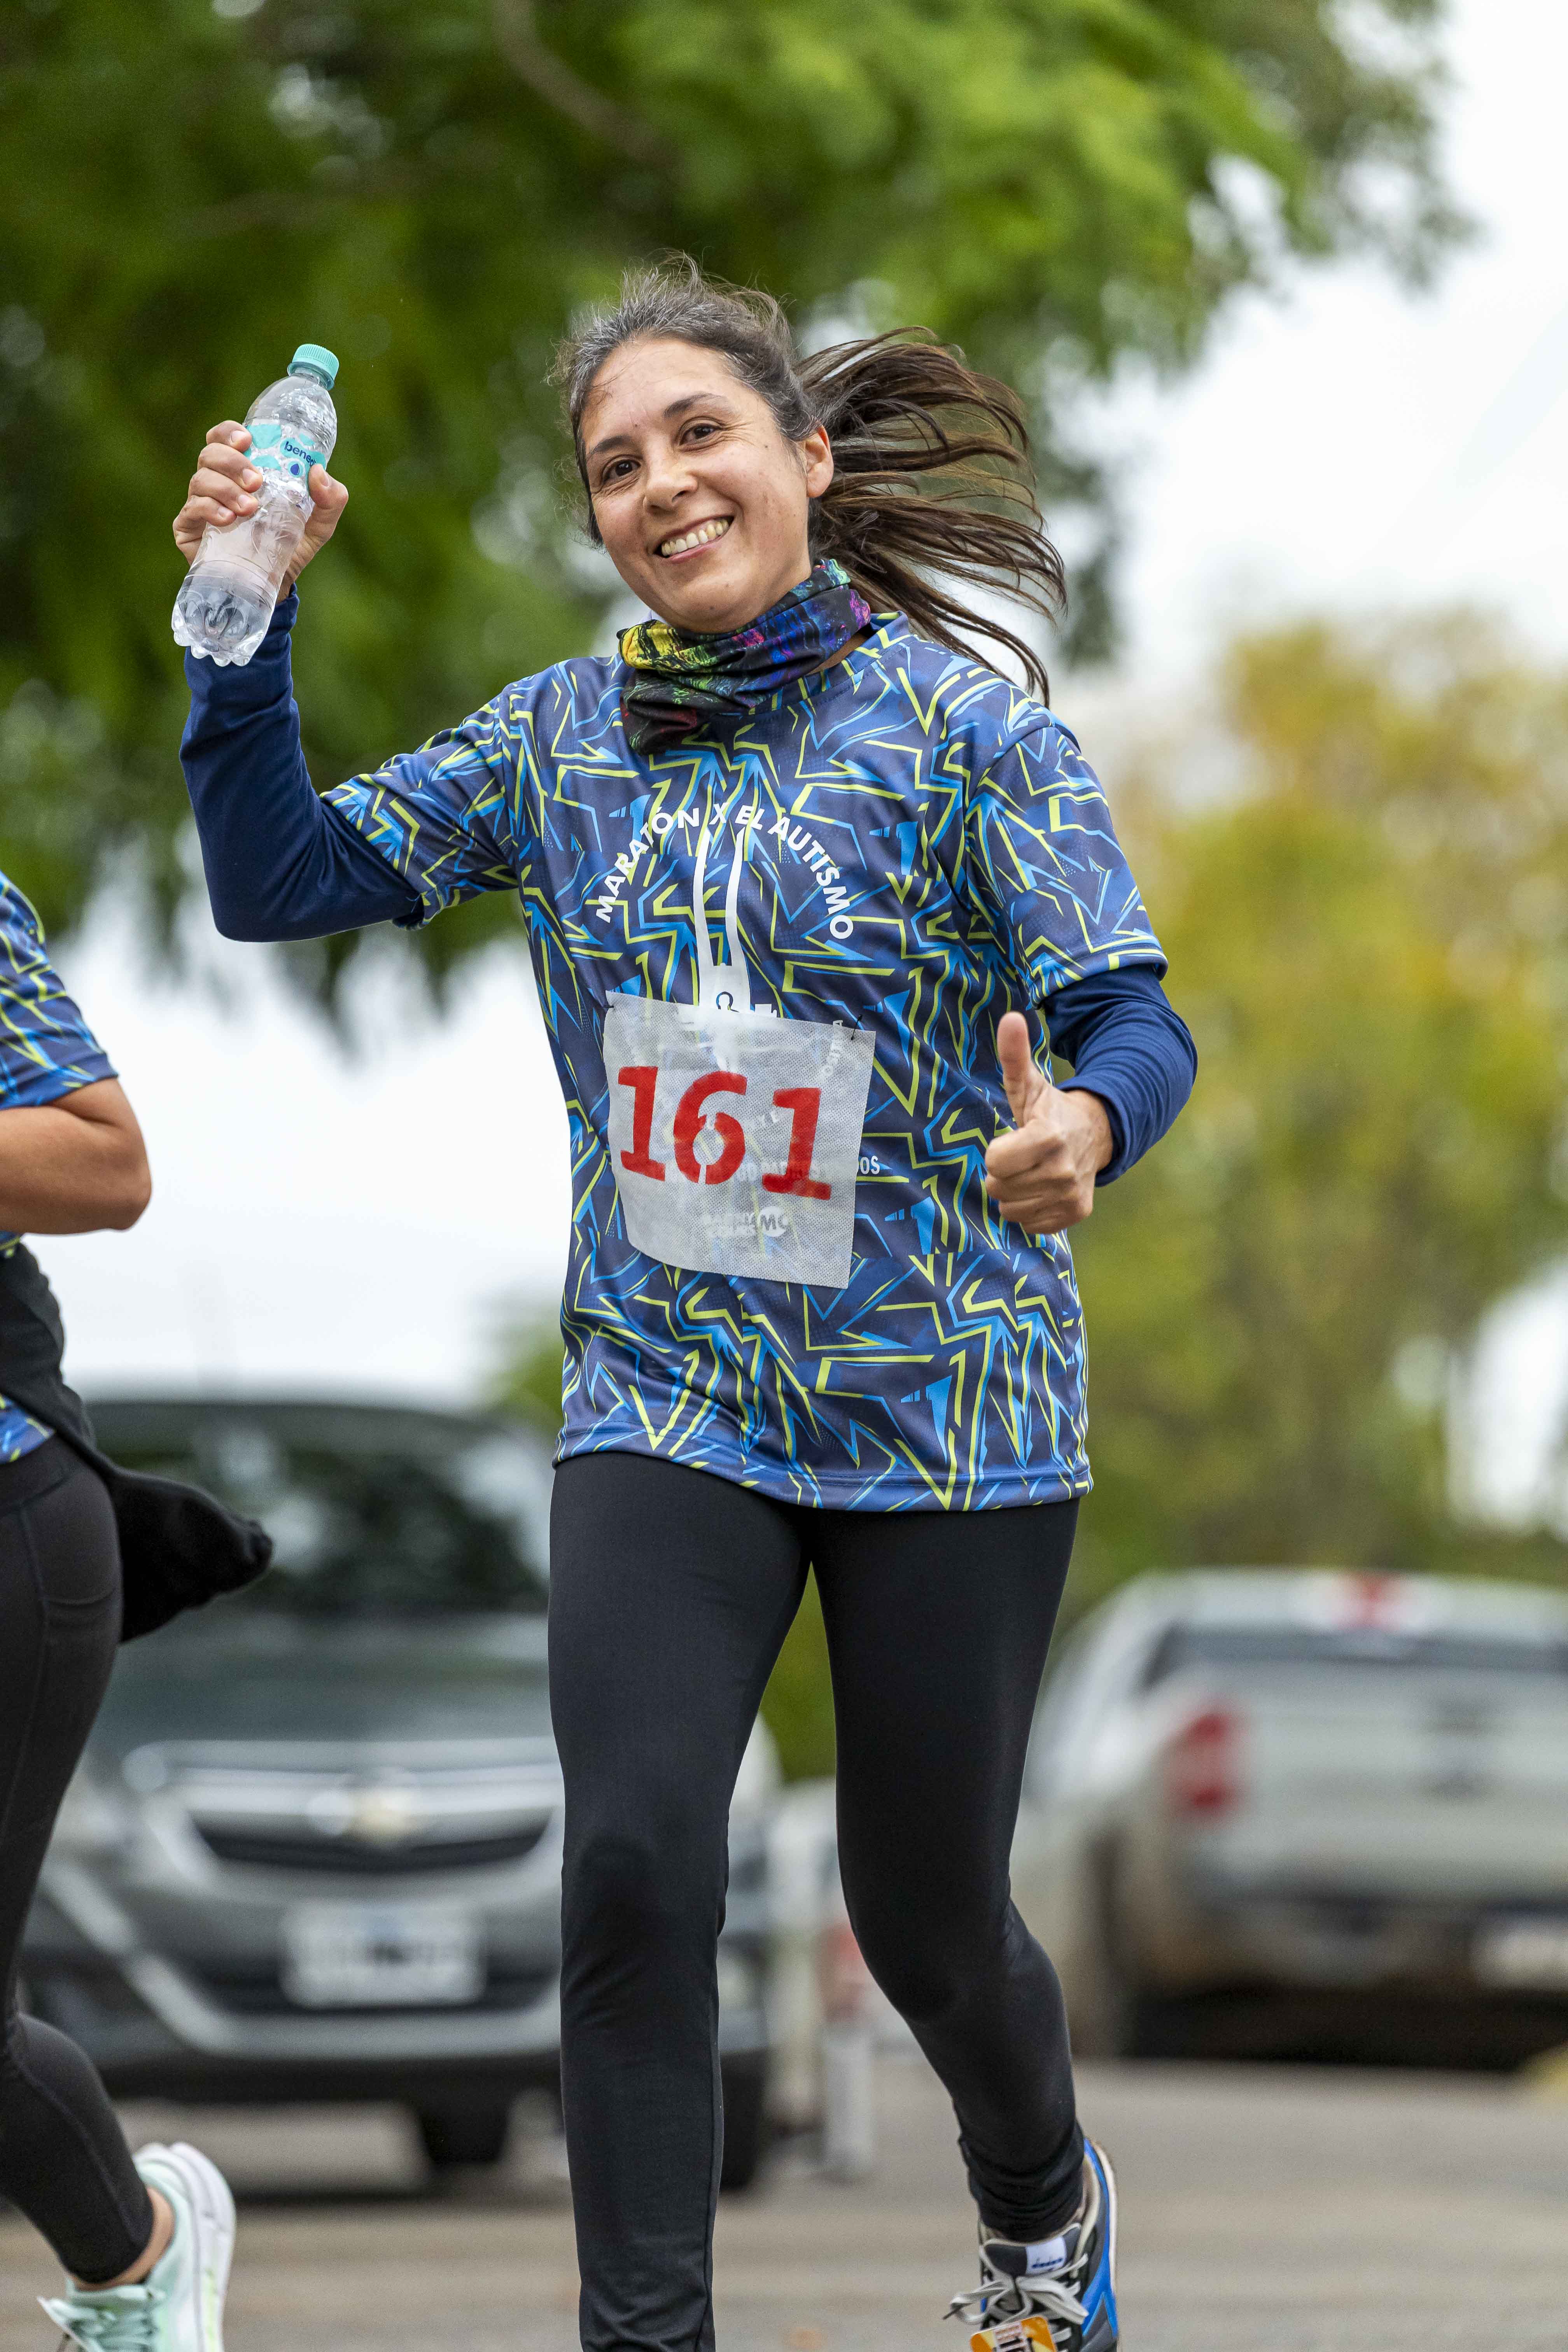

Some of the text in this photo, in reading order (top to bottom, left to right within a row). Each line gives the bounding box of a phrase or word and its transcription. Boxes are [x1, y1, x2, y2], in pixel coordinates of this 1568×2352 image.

[595, 802, 854, 940] MARATÓN X EL AUTISMO
[618, 1066, 832, 1200] 161
